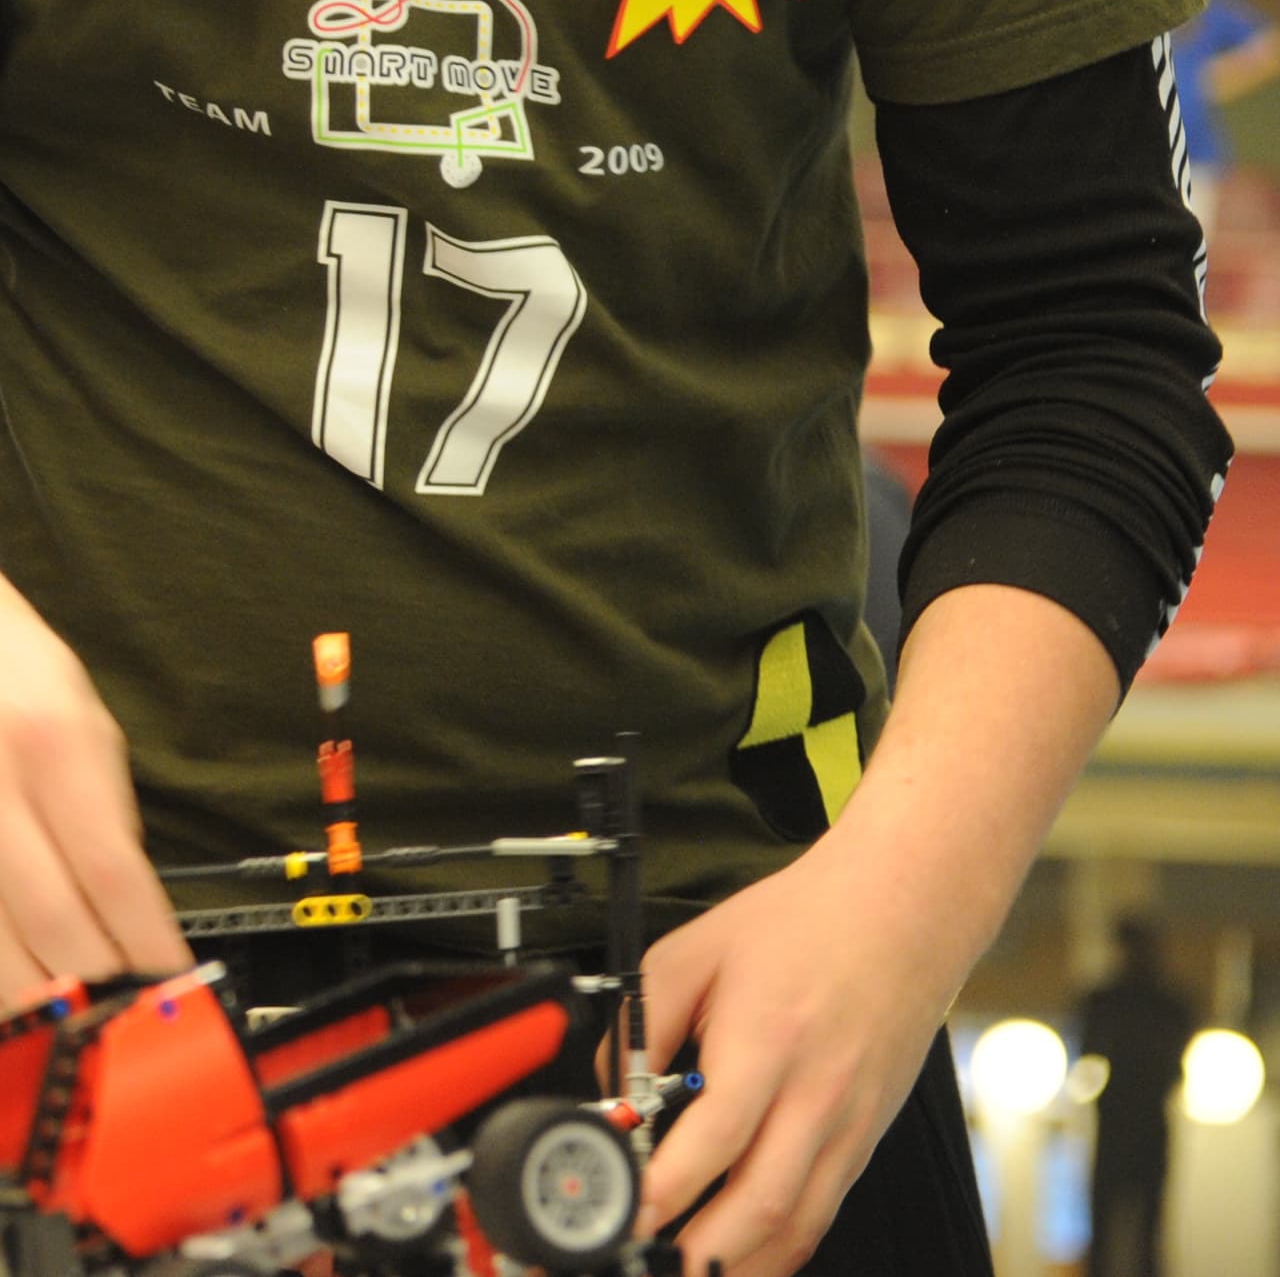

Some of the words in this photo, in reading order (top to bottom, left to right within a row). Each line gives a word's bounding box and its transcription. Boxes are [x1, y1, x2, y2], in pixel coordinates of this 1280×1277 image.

[283, 40, 438, 88] SMART
[442, 56, 561, 105] MOVE
[153, 79, 273, 137] TEAM
[577, 142, 665, 176] 2009
[311, 199, 588, 497] 17
